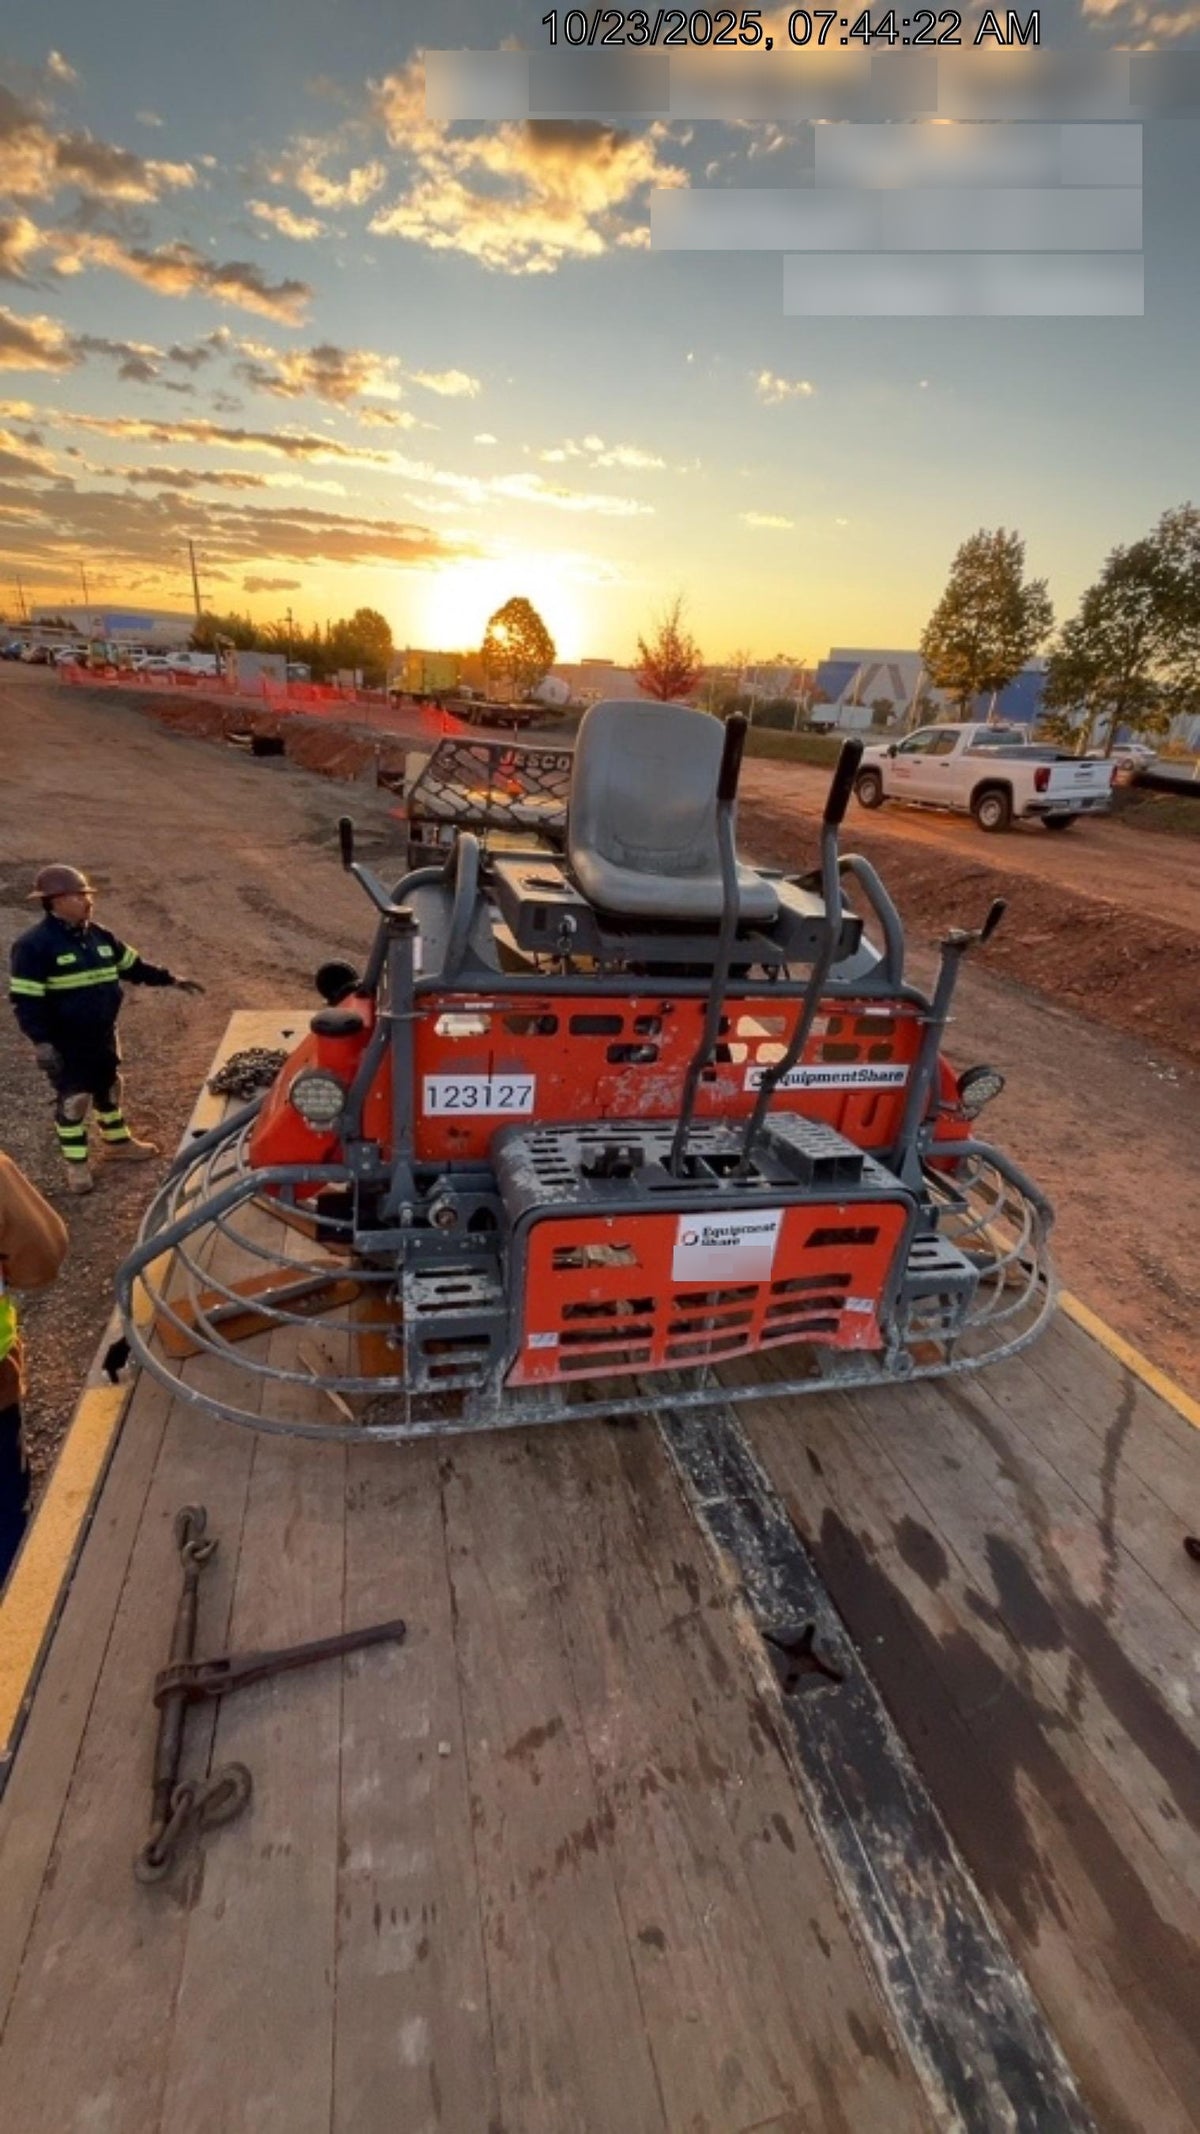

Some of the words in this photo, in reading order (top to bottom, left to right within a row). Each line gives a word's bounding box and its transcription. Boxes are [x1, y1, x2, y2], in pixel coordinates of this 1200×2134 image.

[775, 1068, 904, 1087] quipmentShare
[427, 1085, 532, 1108] 123127
[702, 1223, 776, 1238] Equipment
